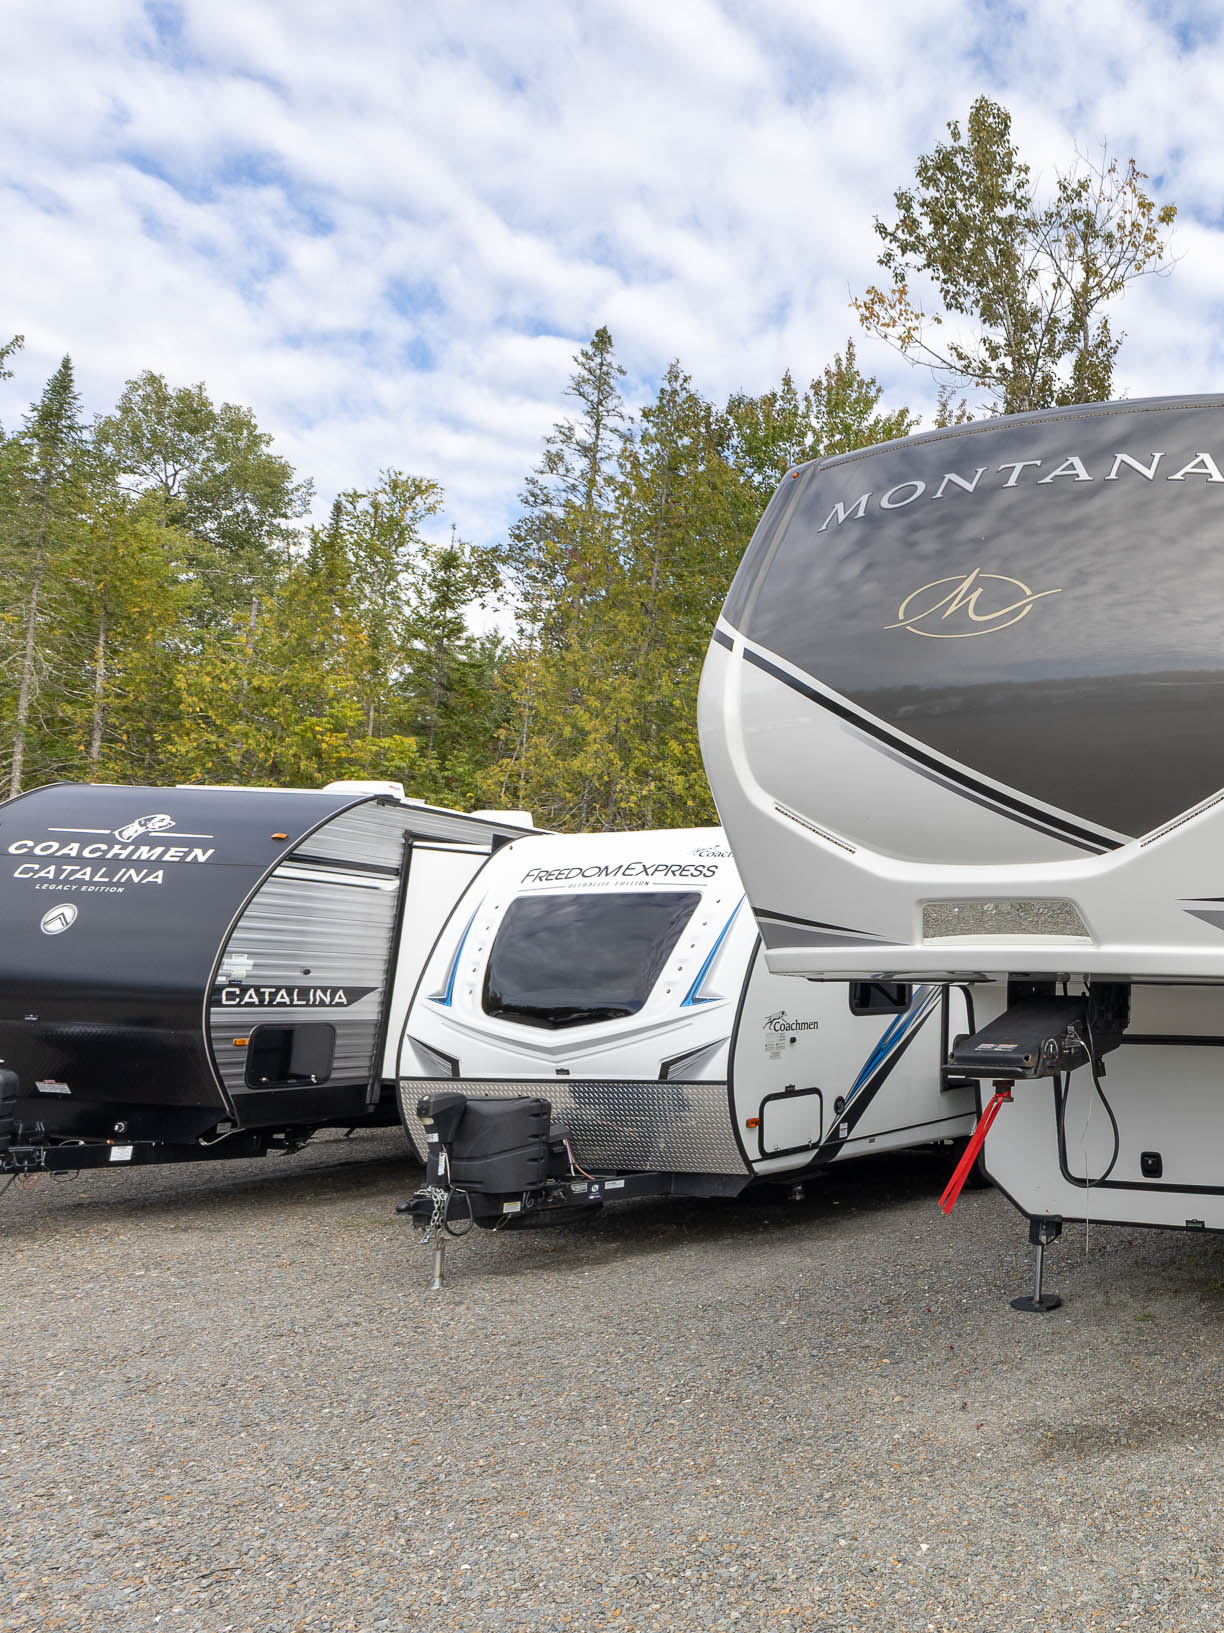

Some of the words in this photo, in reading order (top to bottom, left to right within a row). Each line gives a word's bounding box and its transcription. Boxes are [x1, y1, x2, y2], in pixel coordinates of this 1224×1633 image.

[8, 840, 215, 863] COACHMEN
[13, 863, 164, 884] CATALINA
[35, 883, 77, 891] LEGACY
[81, 885, 125, 893] EDITION
[222, 987, 347, 1005] CATALINA
[773, 1019, 819, 1032] Coachmen
